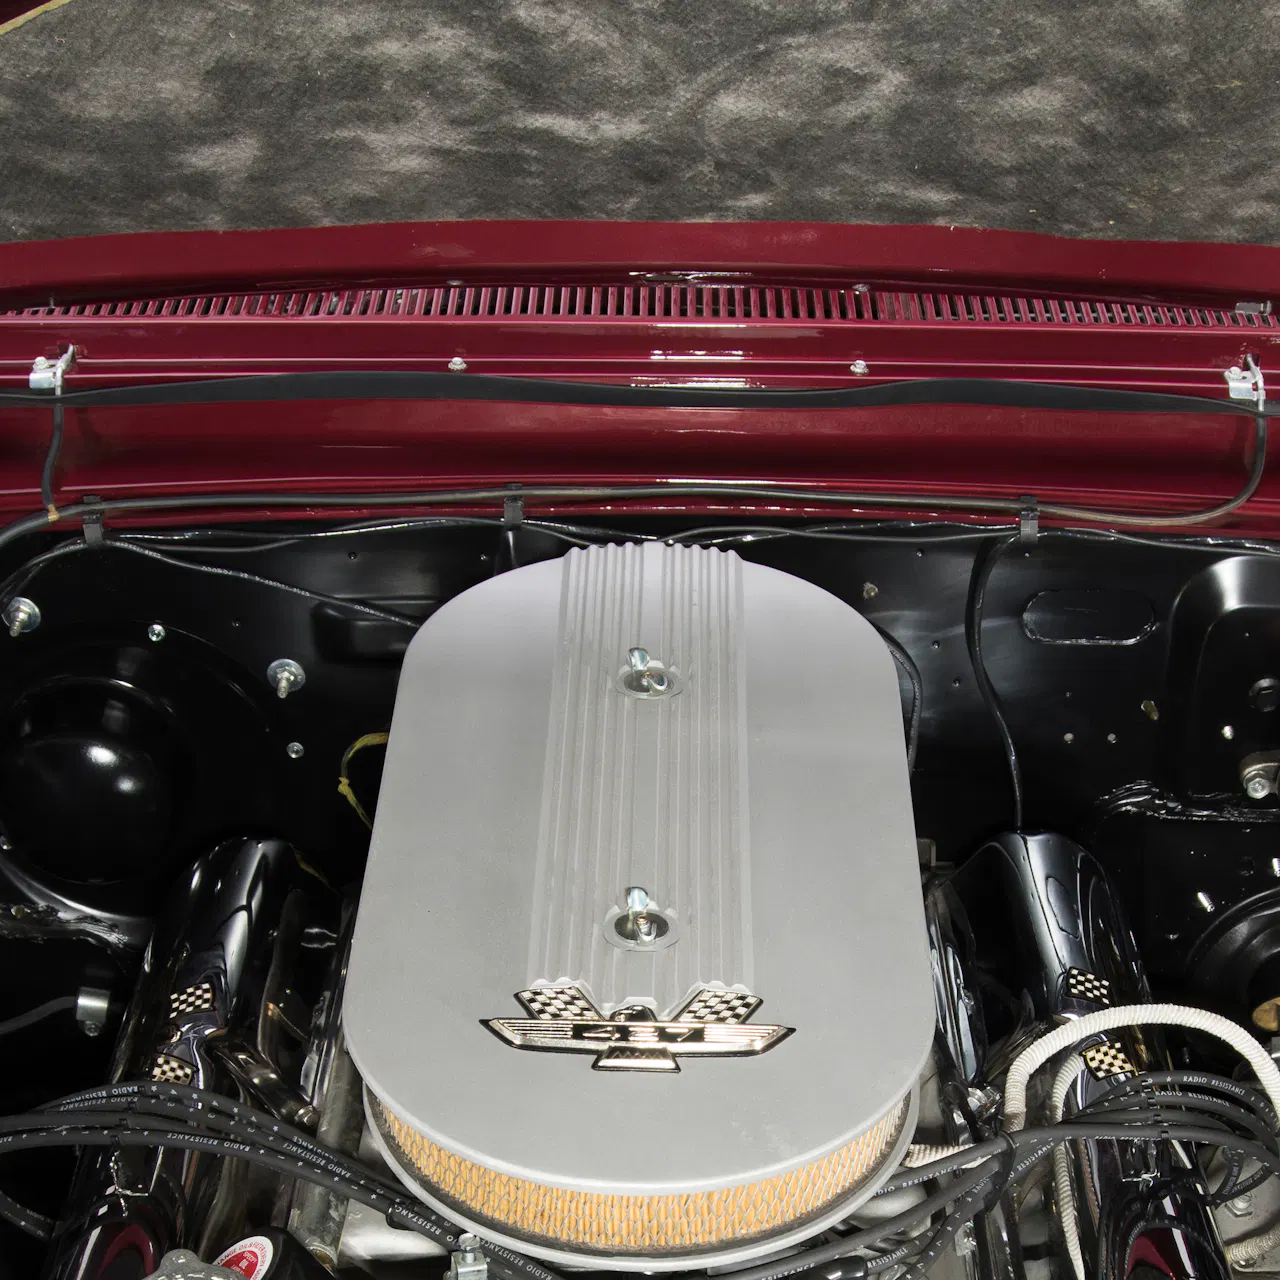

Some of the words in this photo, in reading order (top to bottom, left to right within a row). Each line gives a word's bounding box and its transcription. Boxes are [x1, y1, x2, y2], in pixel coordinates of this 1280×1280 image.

[1183, 1075, 1207, 1084] RADIO
[1211, 1079, 1246, 1095] RESISTANCE
[224, 1141, 252, 1152] RADIO
[282, 1142, 326, 1166] RESISTANCE
[328, 1162, 352, 1179] RADIO
[480, 1237, 524, 1265] RESISTANCE
[867, 1246, 909, 1269] RESISTANCE
